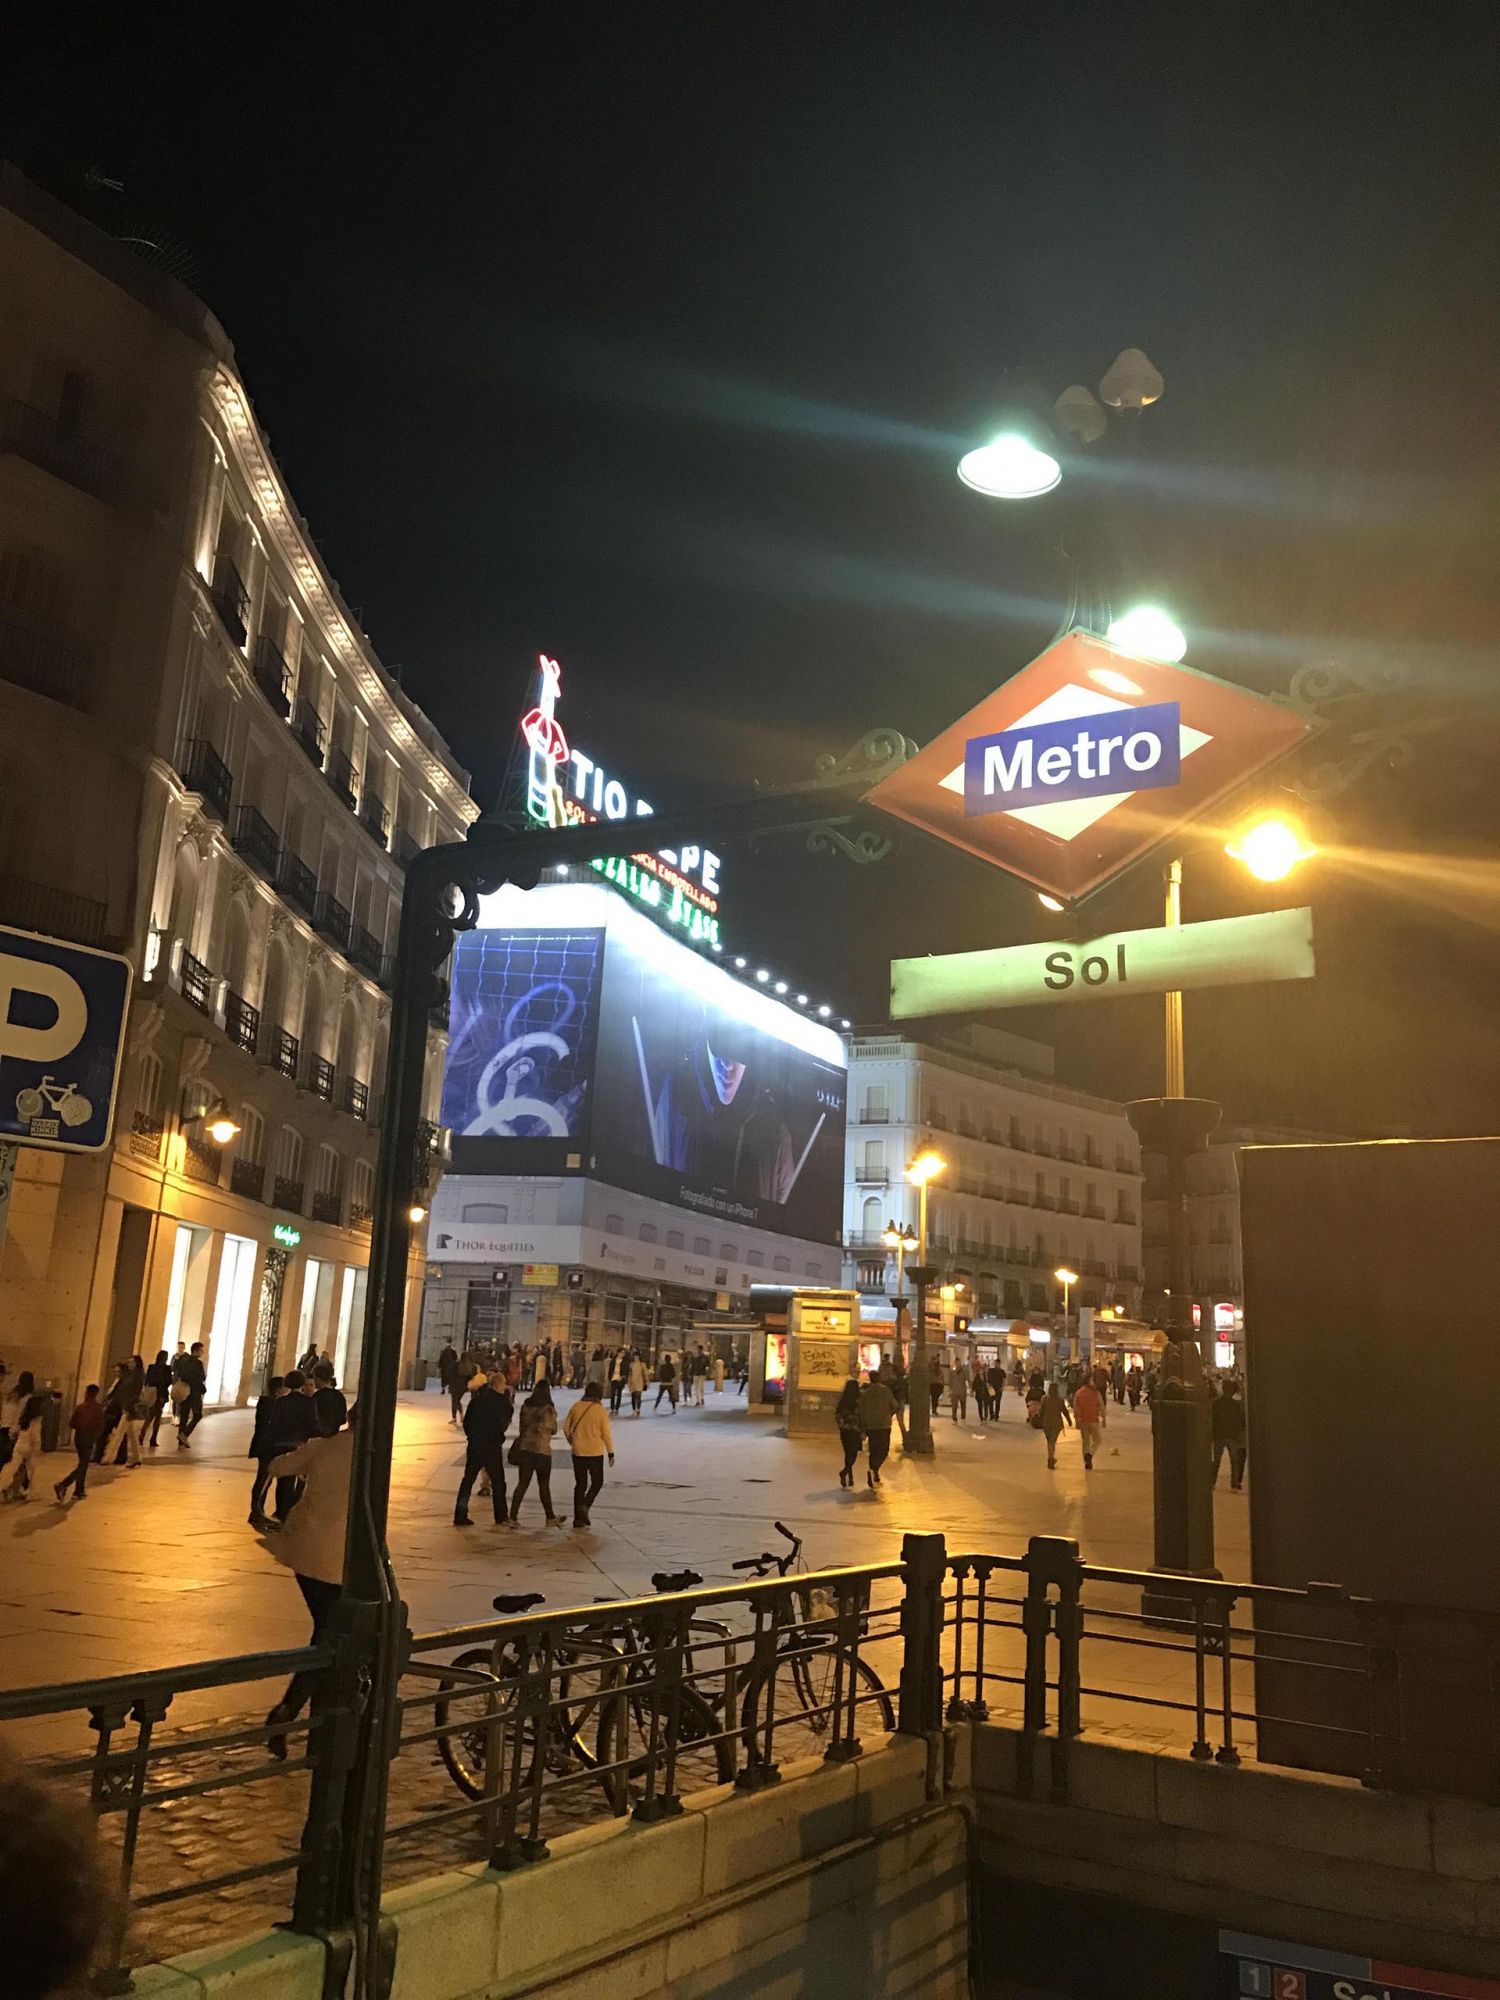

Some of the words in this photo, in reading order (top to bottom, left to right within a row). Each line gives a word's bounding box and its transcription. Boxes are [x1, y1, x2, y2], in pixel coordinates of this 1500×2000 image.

[983, 729, 1162, 795] Metro
[1043, 943, 1127, 991] Sol
[0, 952, 88, 1063] P
[455, 1239, 486, 1251] THOR
[489, 1241, 535, 1252] EQUITIES
[1248, 1966, 1260, 1992] 1
[1281, 1973, 1299, 2000] 2
